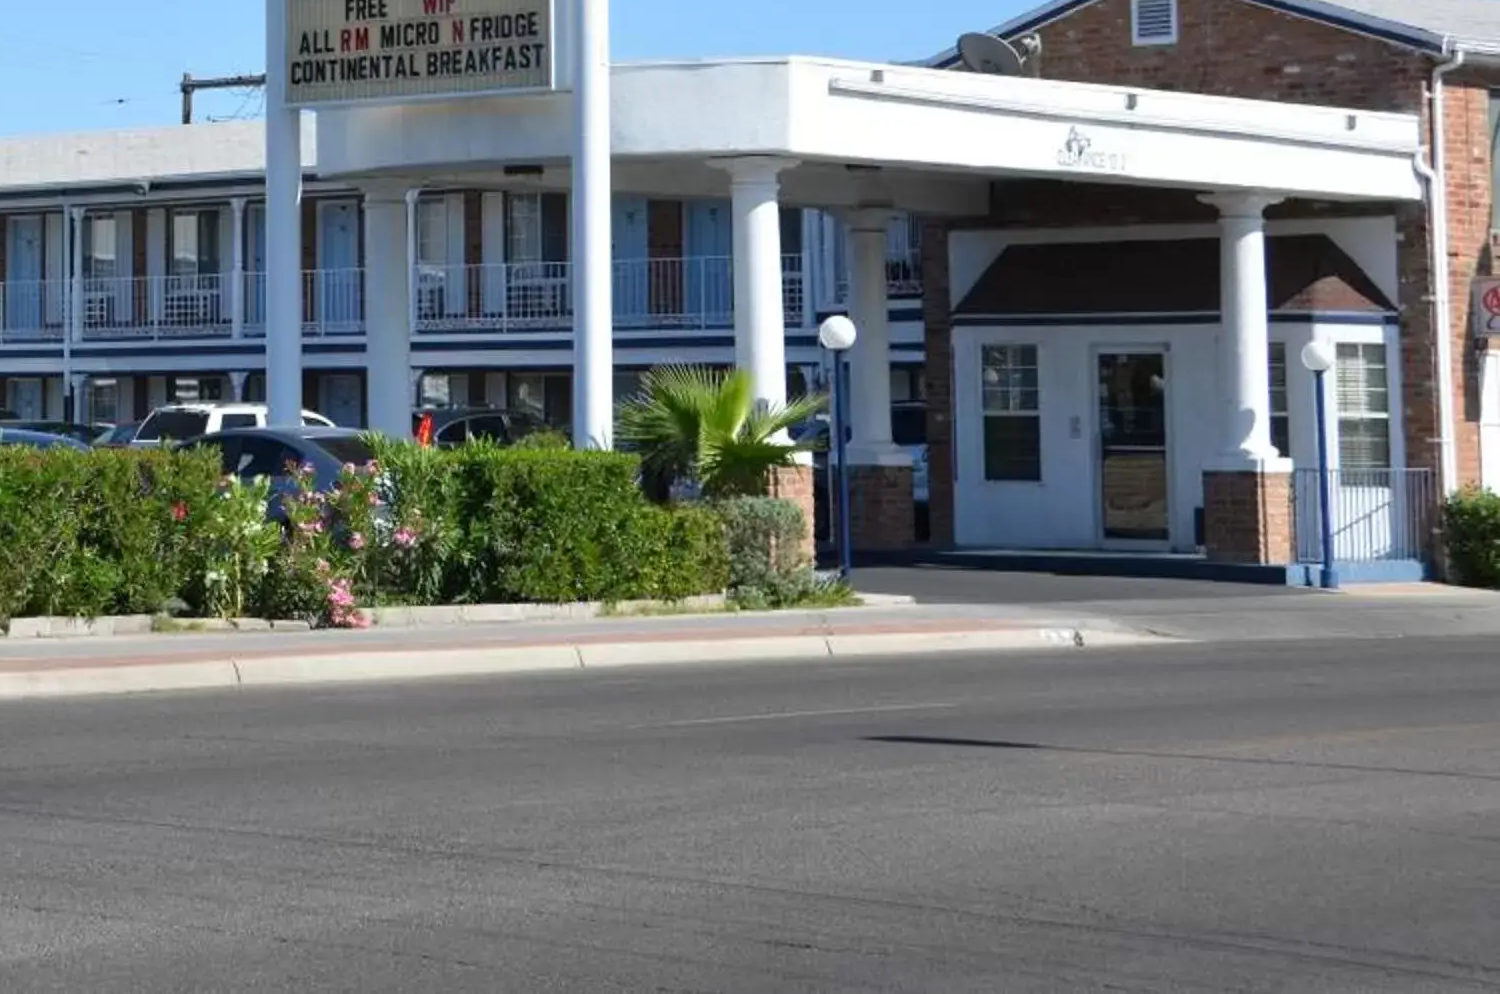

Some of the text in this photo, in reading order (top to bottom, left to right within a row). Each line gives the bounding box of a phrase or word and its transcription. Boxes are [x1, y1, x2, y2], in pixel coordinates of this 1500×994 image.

[299, 13, 538, 55] ALL RM MICRO N FRIDGE
[291, 44, 545, 85] CONTINENTAL BREAKFAST
